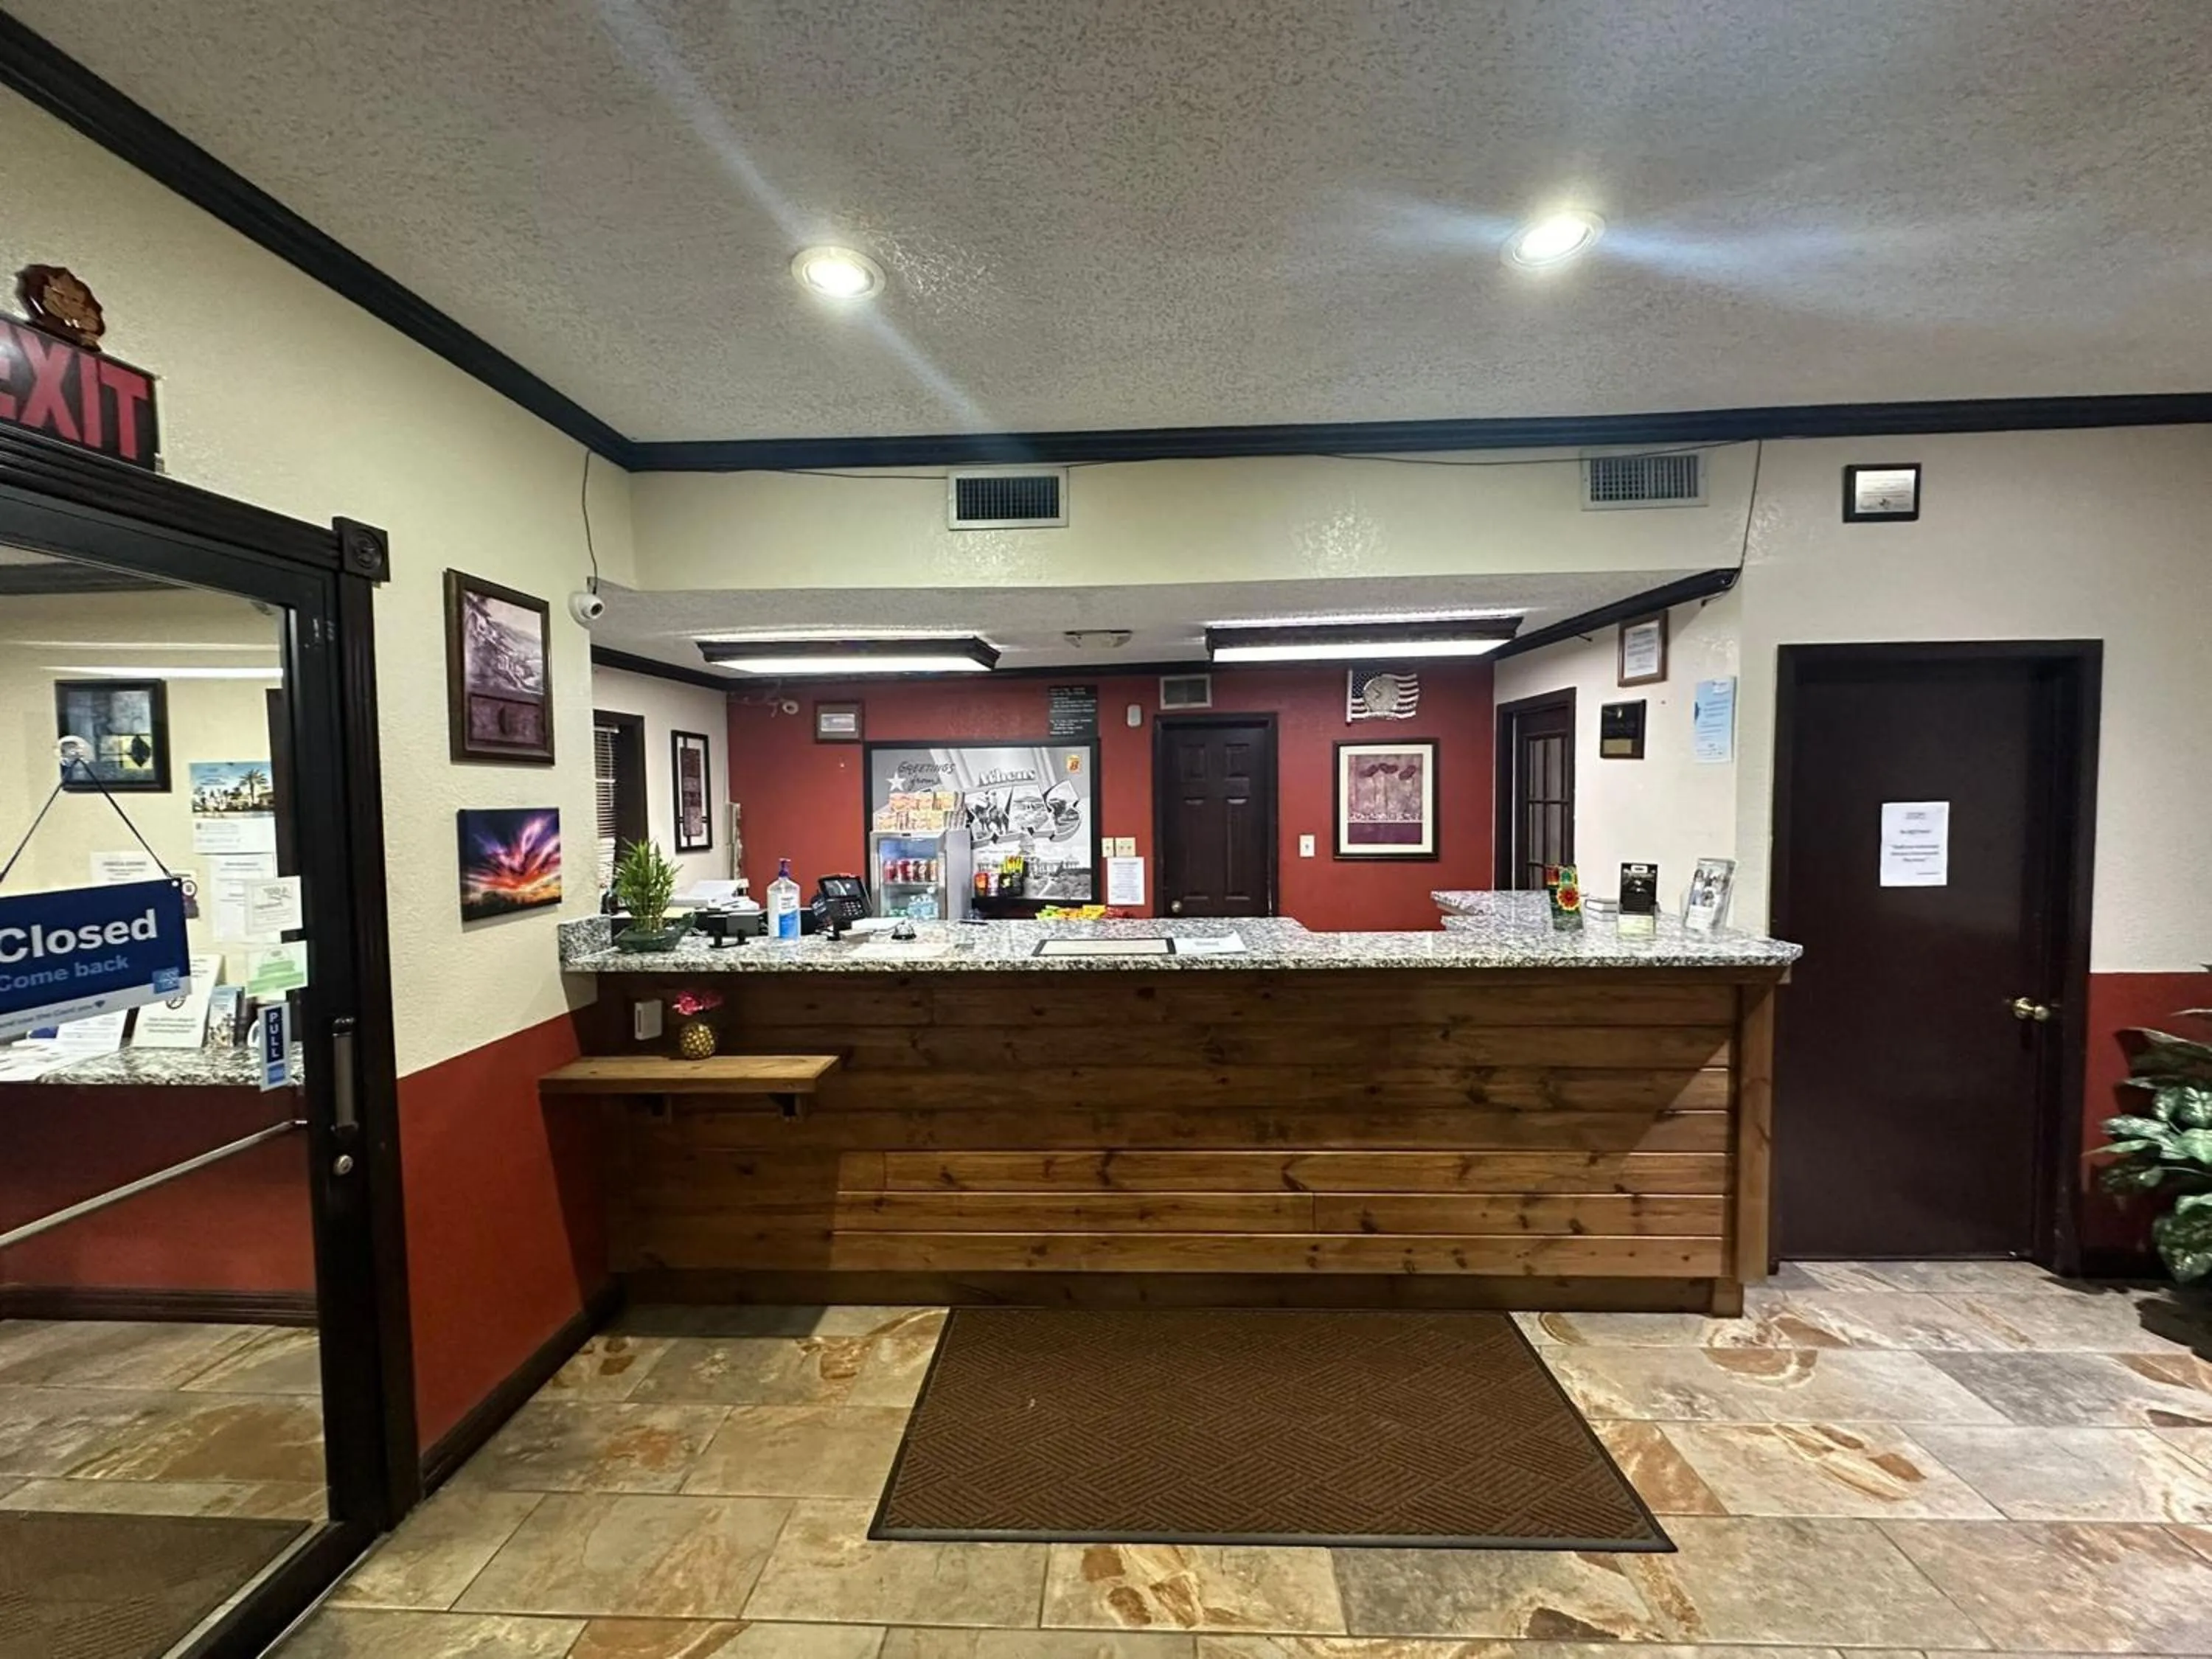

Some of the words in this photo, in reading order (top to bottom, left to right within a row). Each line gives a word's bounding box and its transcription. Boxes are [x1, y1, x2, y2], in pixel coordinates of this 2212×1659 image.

[0, 908, 158, 963] Closed
[0, 968, 69, 992] Come
[74, 955, 129, 978] back
[269, 1012, 279, 1058] PULL
